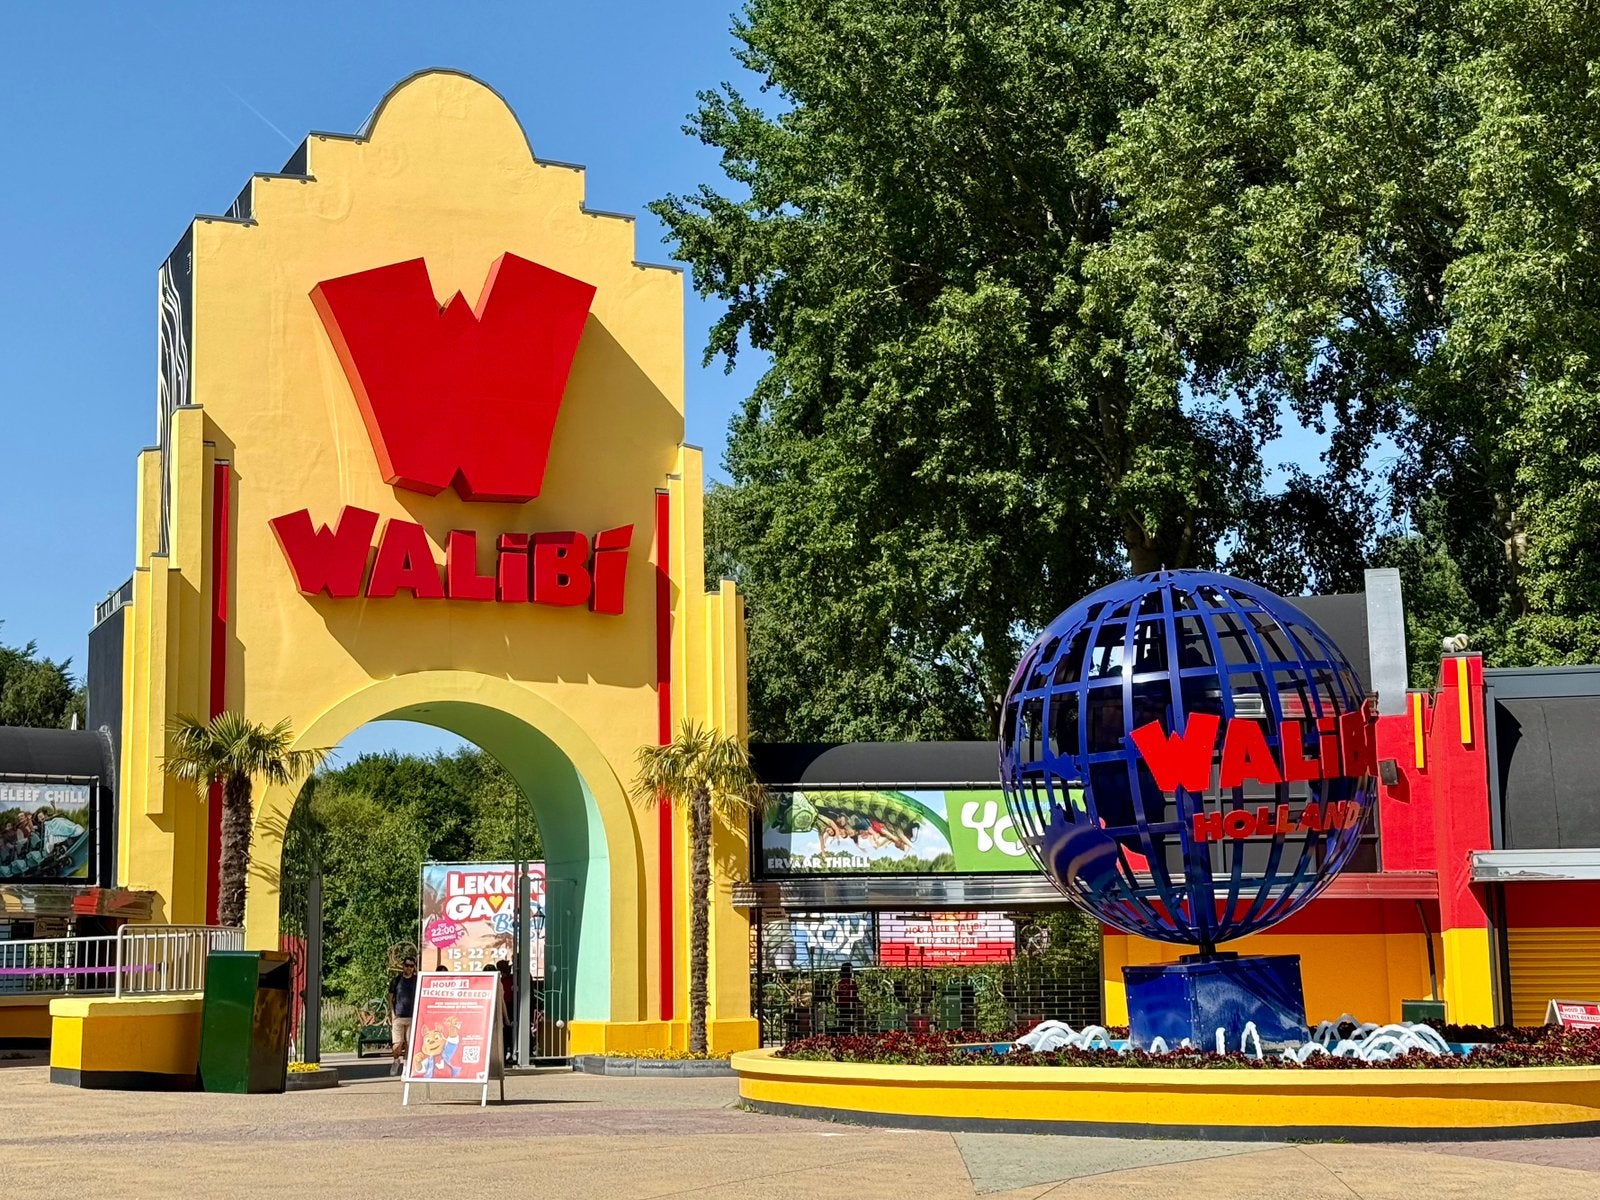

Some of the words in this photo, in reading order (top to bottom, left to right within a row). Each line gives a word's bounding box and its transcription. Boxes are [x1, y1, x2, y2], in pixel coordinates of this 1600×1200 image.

[308, 251, 597, 504] W
[1193, 800, 1360, 842] HOLLAND
[767, 857, 822, 869] ERVAAR
[450, 873, 544, 896] LEKKR
[446, 894, 545, 921] GAA
[431, 925, 455, 937] 22:00
[448, 948, 461, 959] 15
[468, 948, 483, 959] 22
[490, 948, 508, 959] 29
[453, 961, 462, 971] 5
[469, 961, 482, 971] 12
